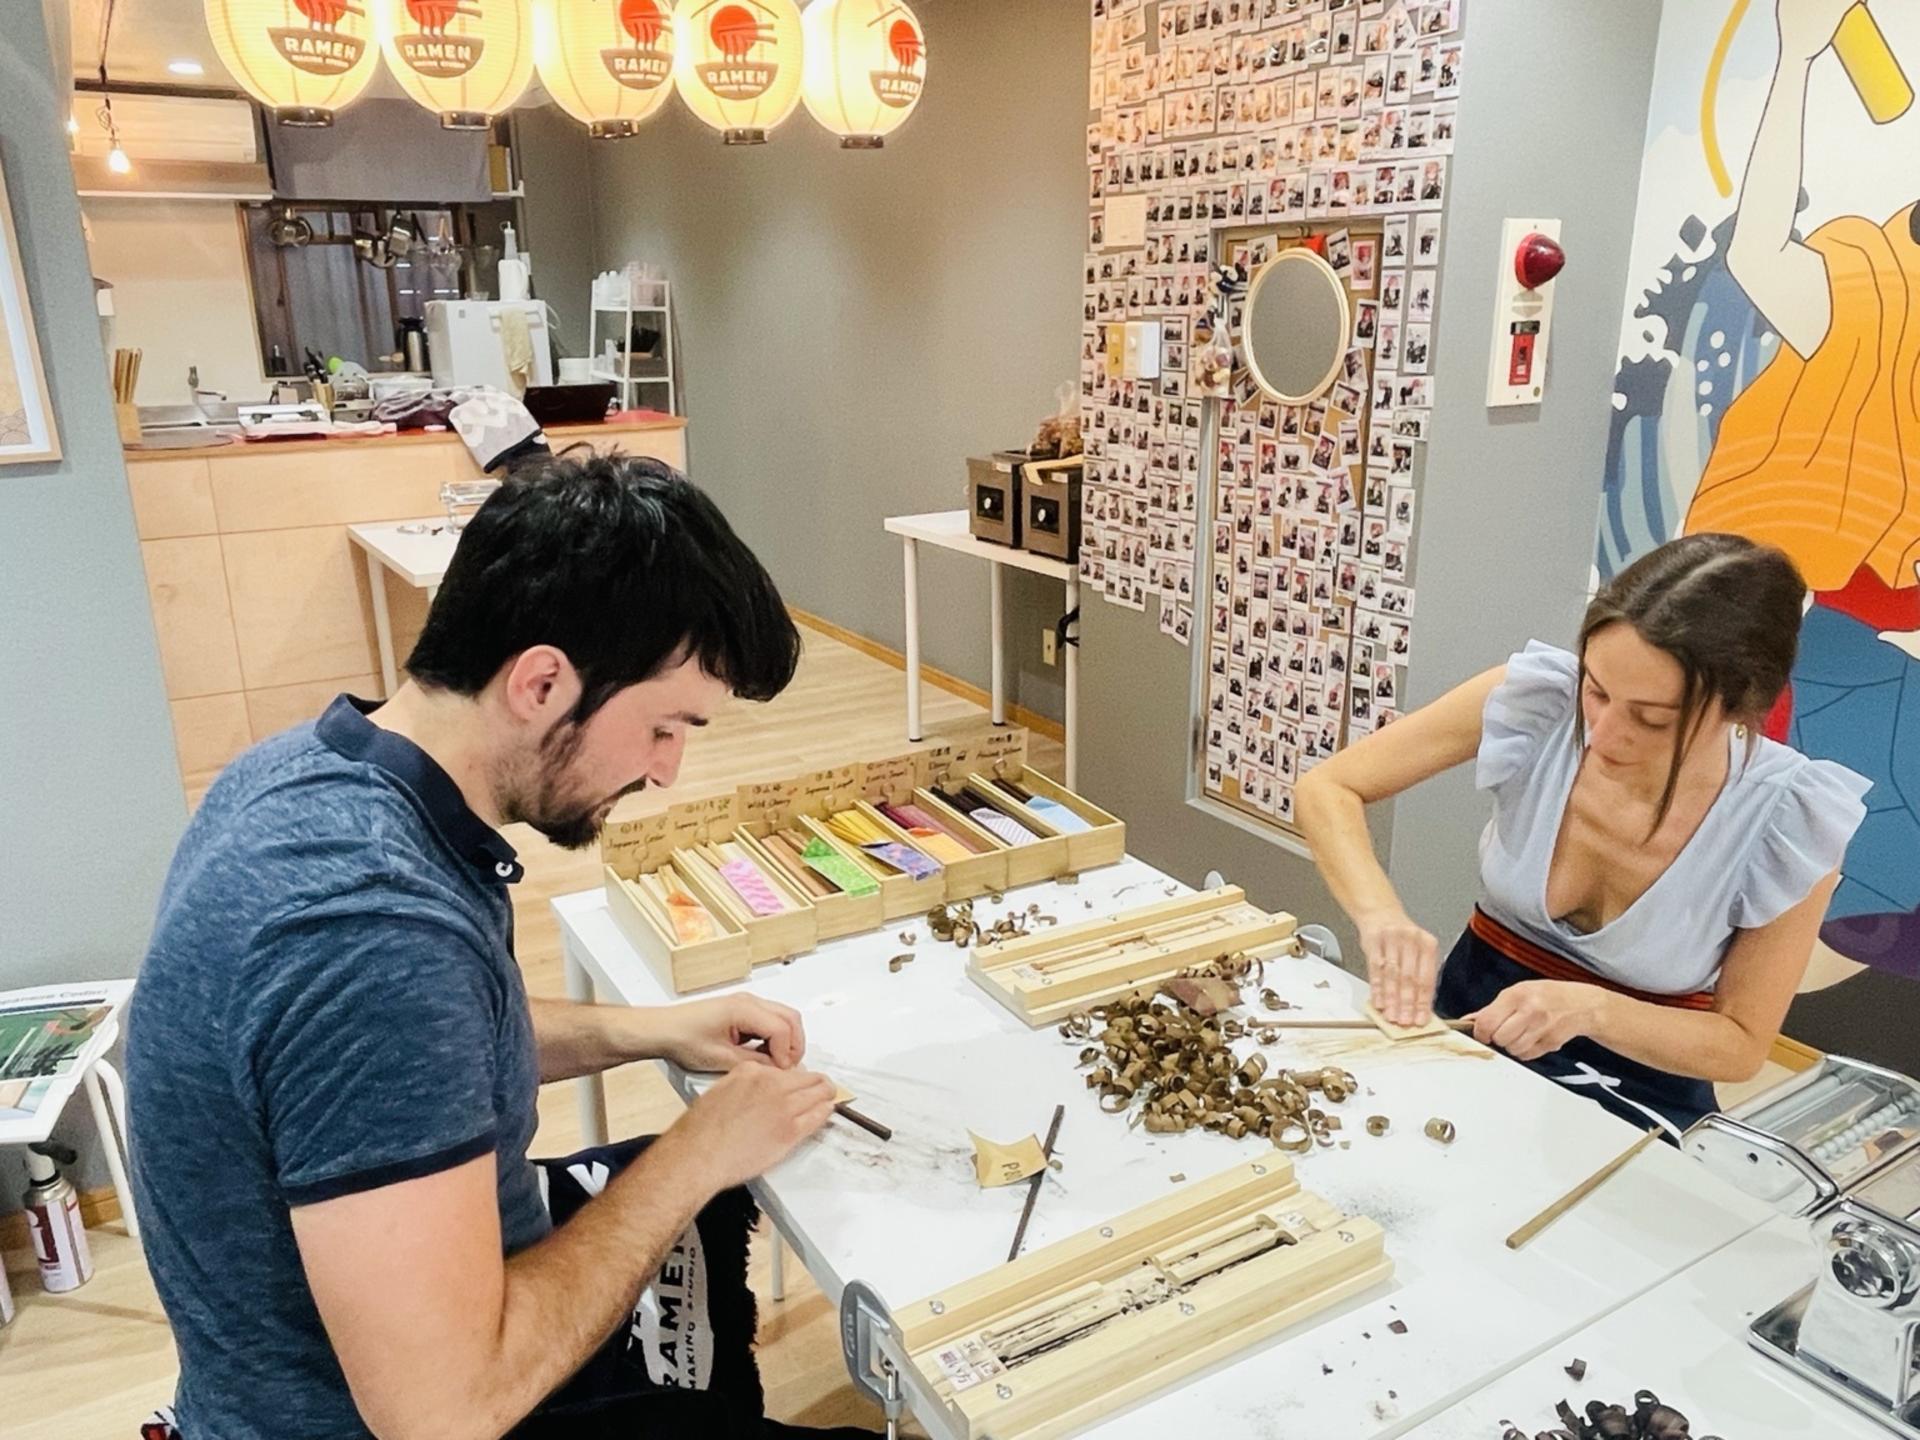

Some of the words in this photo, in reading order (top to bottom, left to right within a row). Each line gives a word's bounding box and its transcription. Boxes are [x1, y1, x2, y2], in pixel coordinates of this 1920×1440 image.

[284, 36, 356, 59] RAMEN
[403, 43, 472, 61] RAMEN
[706, 70, 768, 84] RAMEN
[686, 1247, 696, 1311] STUDIO
[684, 1322, 697, 1389] MAKING
